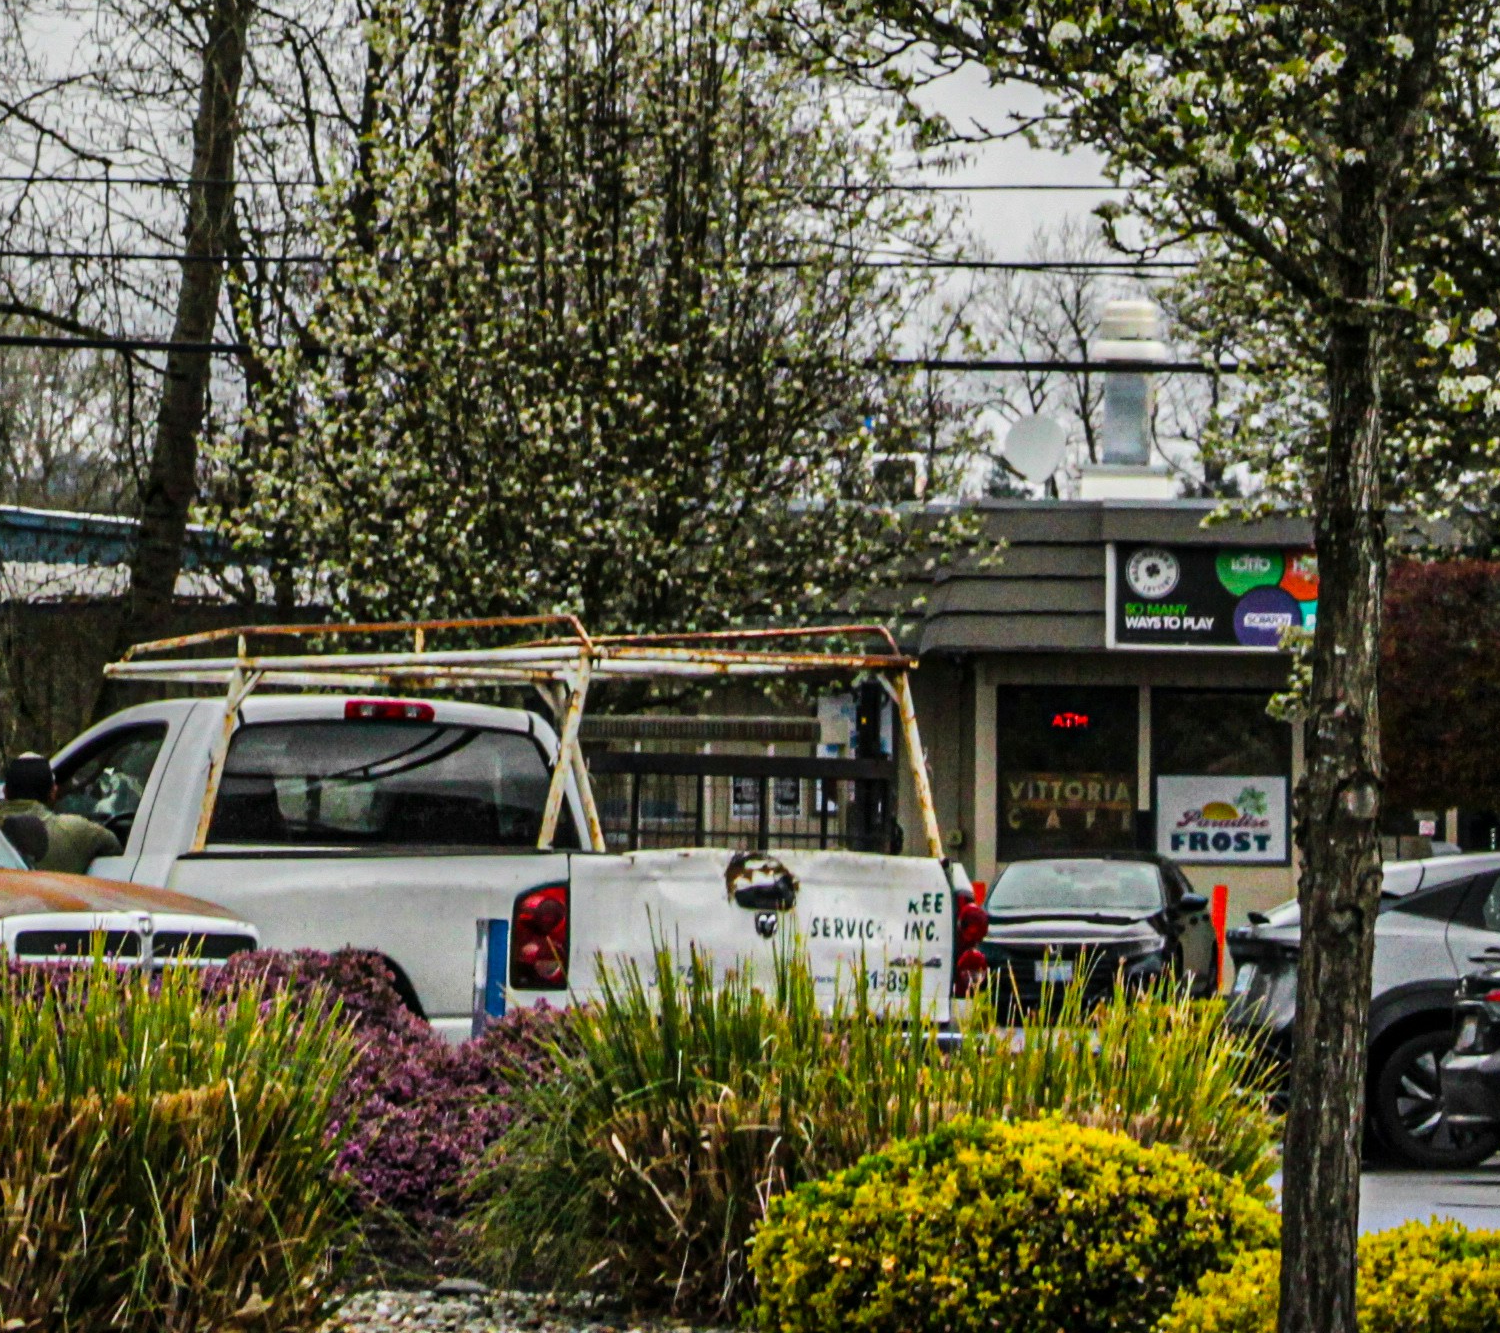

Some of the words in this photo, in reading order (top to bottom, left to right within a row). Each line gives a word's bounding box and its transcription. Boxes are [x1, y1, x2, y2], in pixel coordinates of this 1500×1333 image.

[1125, 603, 1143, 615] SO
[1147, 604, 1187, 615] MANY
[1125, 616, 1161, 629] WAYS
[1163, 616, 1181, 629] TO
[1183, 616, 1214, 630] PLAY
[1052, 712, 1088, 727] ATM
[1008, 781, 1131, 801] VITTORIA
[1176, 808, 1269, 828] Paradise
[1170, 831, 1271, 852] FROST
[904, 920, 940, 941] INC.
